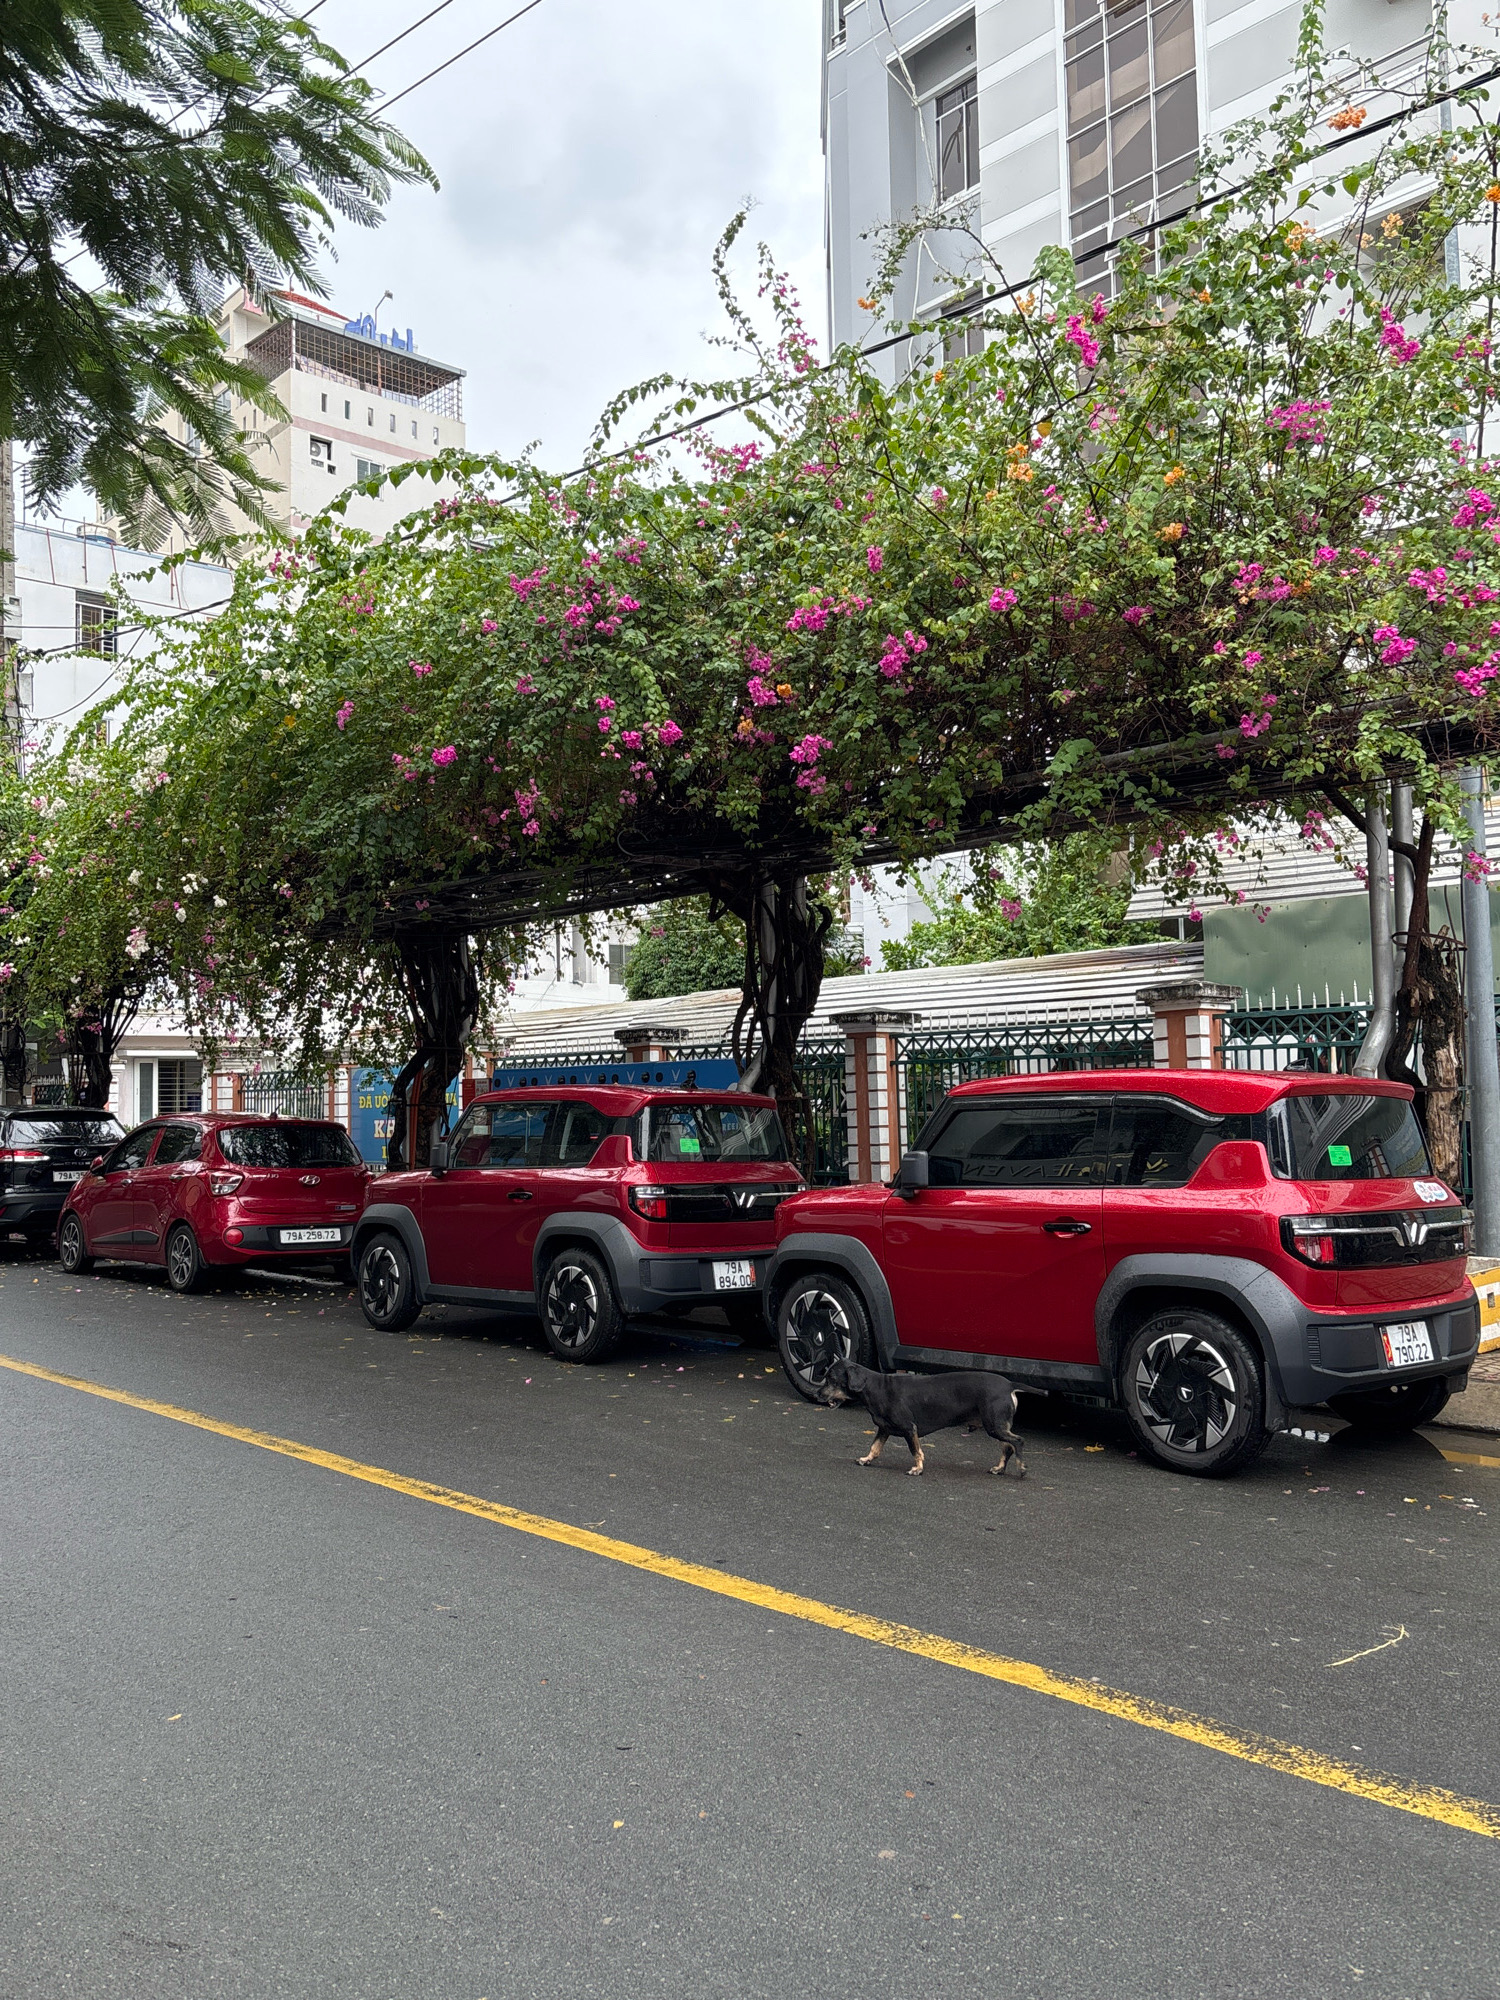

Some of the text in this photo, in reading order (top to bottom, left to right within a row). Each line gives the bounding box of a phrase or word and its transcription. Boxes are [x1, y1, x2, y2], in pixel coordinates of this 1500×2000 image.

[358, 1093, 373, 1109] ĐÃ
[286, 1231, 336, 1241] 79A-258.72
[725, 1262, 743, 1275] 79A
[719, 1274, 752, 1288] 894.00
[1398, 1324, 1419, 1343] 79A
[1395, 1343, 1430, 1364] 790.22
